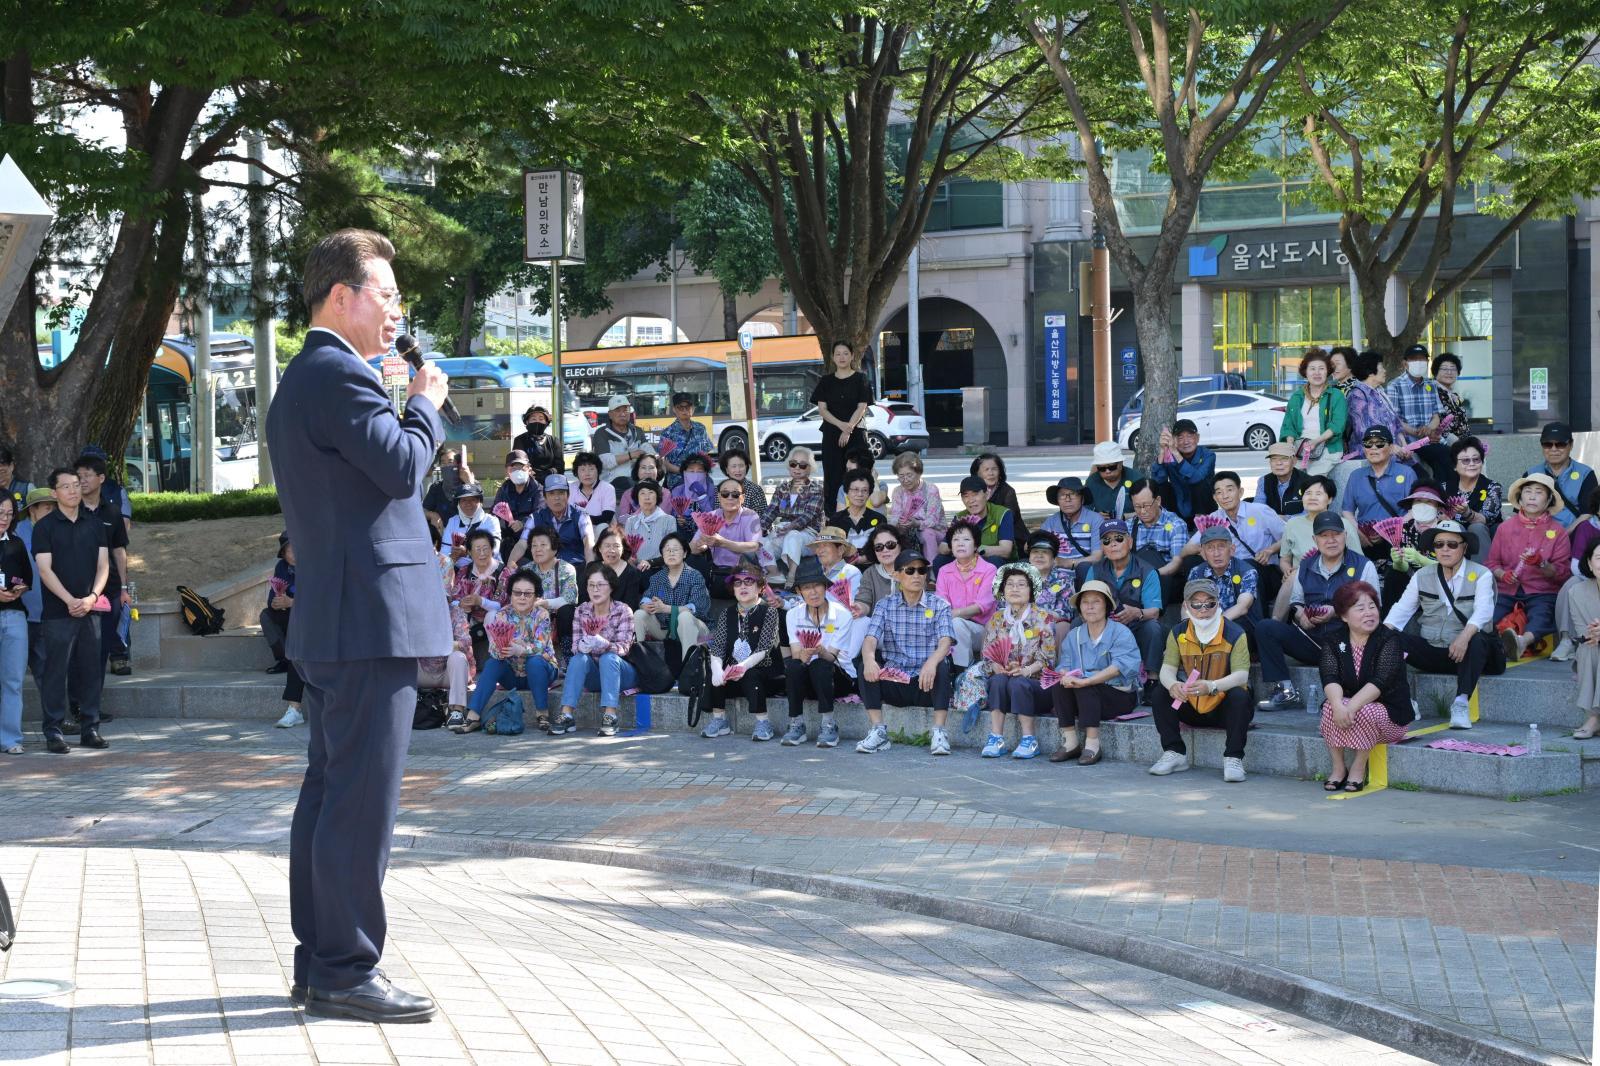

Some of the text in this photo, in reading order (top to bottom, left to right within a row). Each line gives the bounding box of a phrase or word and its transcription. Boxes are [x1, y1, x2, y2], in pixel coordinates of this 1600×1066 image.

[1232, 239, 1350, 271] 울산도시공
[565, 366, 605, 377] ELEC CITY
[1051, 328, 1060, 419] 울산지방노동위원회
